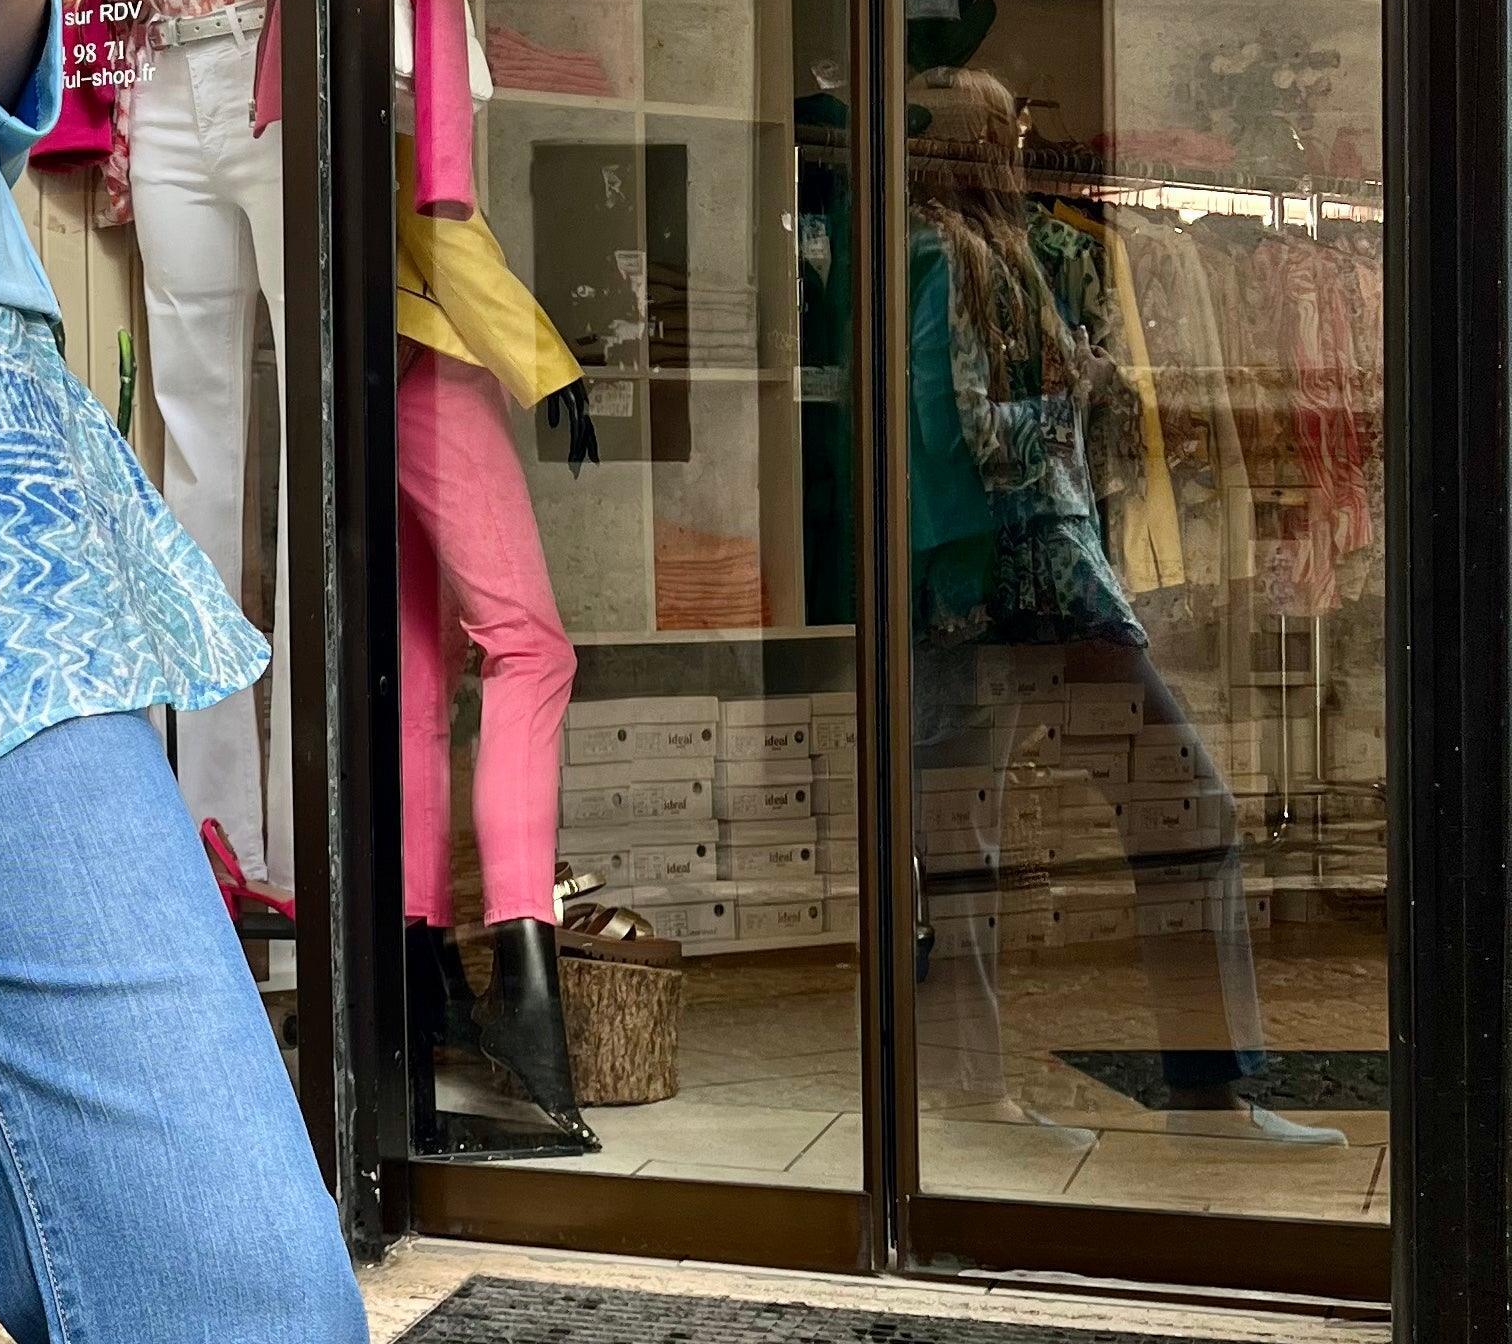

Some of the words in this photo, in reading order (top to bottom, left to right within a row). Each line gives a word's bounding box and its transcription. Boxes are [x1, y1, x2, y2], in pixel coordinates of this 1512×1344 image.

[64, 9, 94, 26] sur
[99, 0, 143, 23] RDV
[72, 42, 98, 65] 98
[103, 40, 125, 61] 71
[764, 734, 788, 747] ideal
